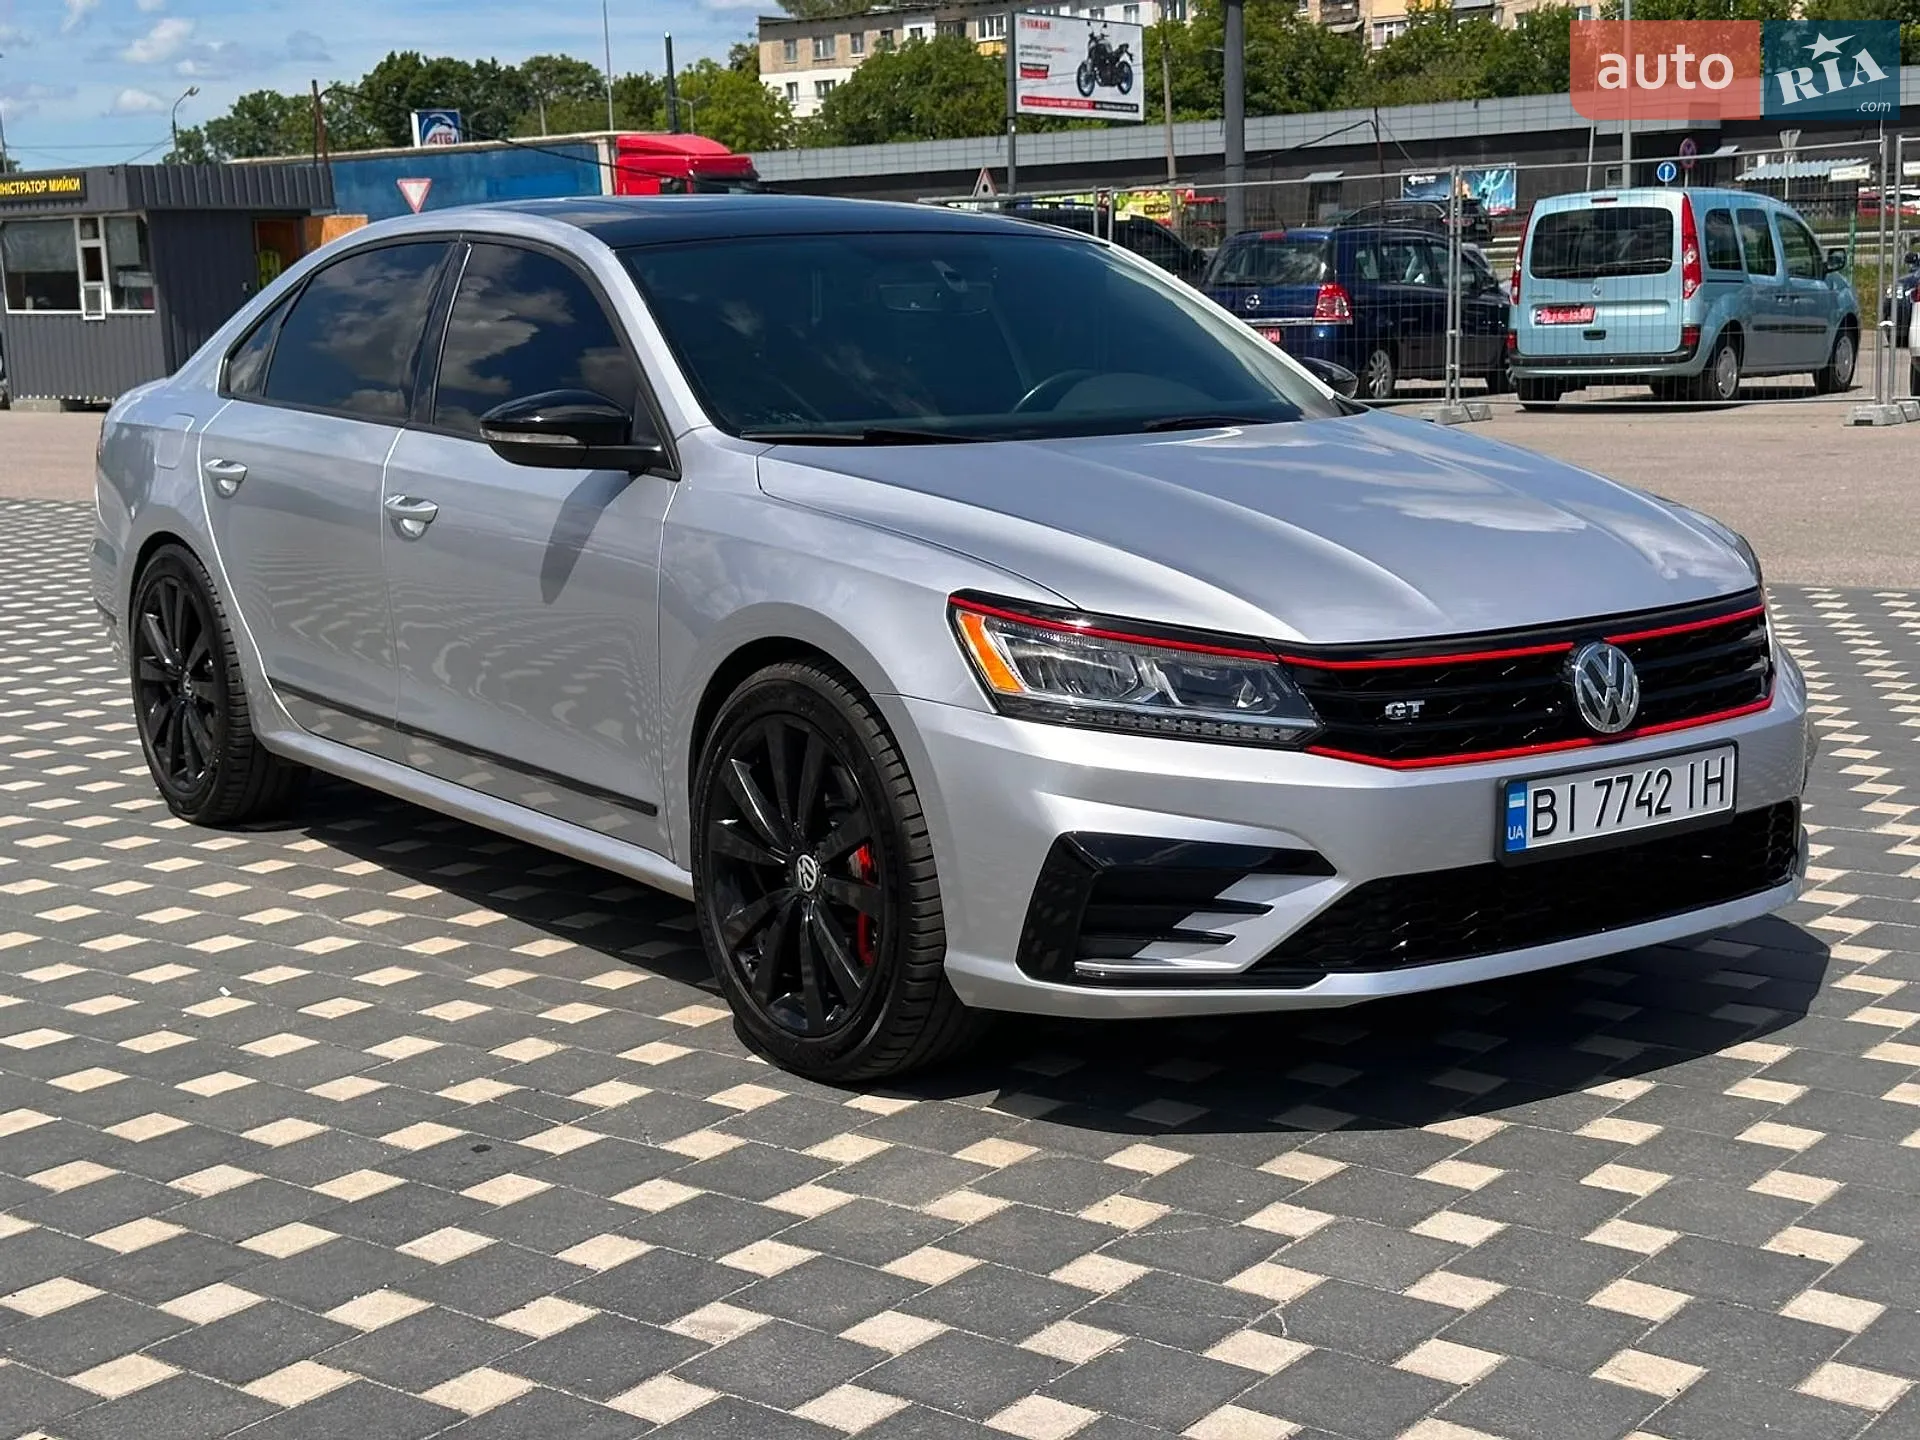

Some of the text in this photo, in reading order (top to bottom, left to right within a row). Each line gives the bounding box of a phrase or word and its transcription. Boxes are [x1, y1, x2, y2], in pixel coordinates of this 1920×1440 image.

[48, 175, 81, 192] МИЙКИ
[1385, 700, 1426, 720] GT
[1532, 756, 1726, 838] BI 7742 IH
[1507, 825, 1525, 840] UA
